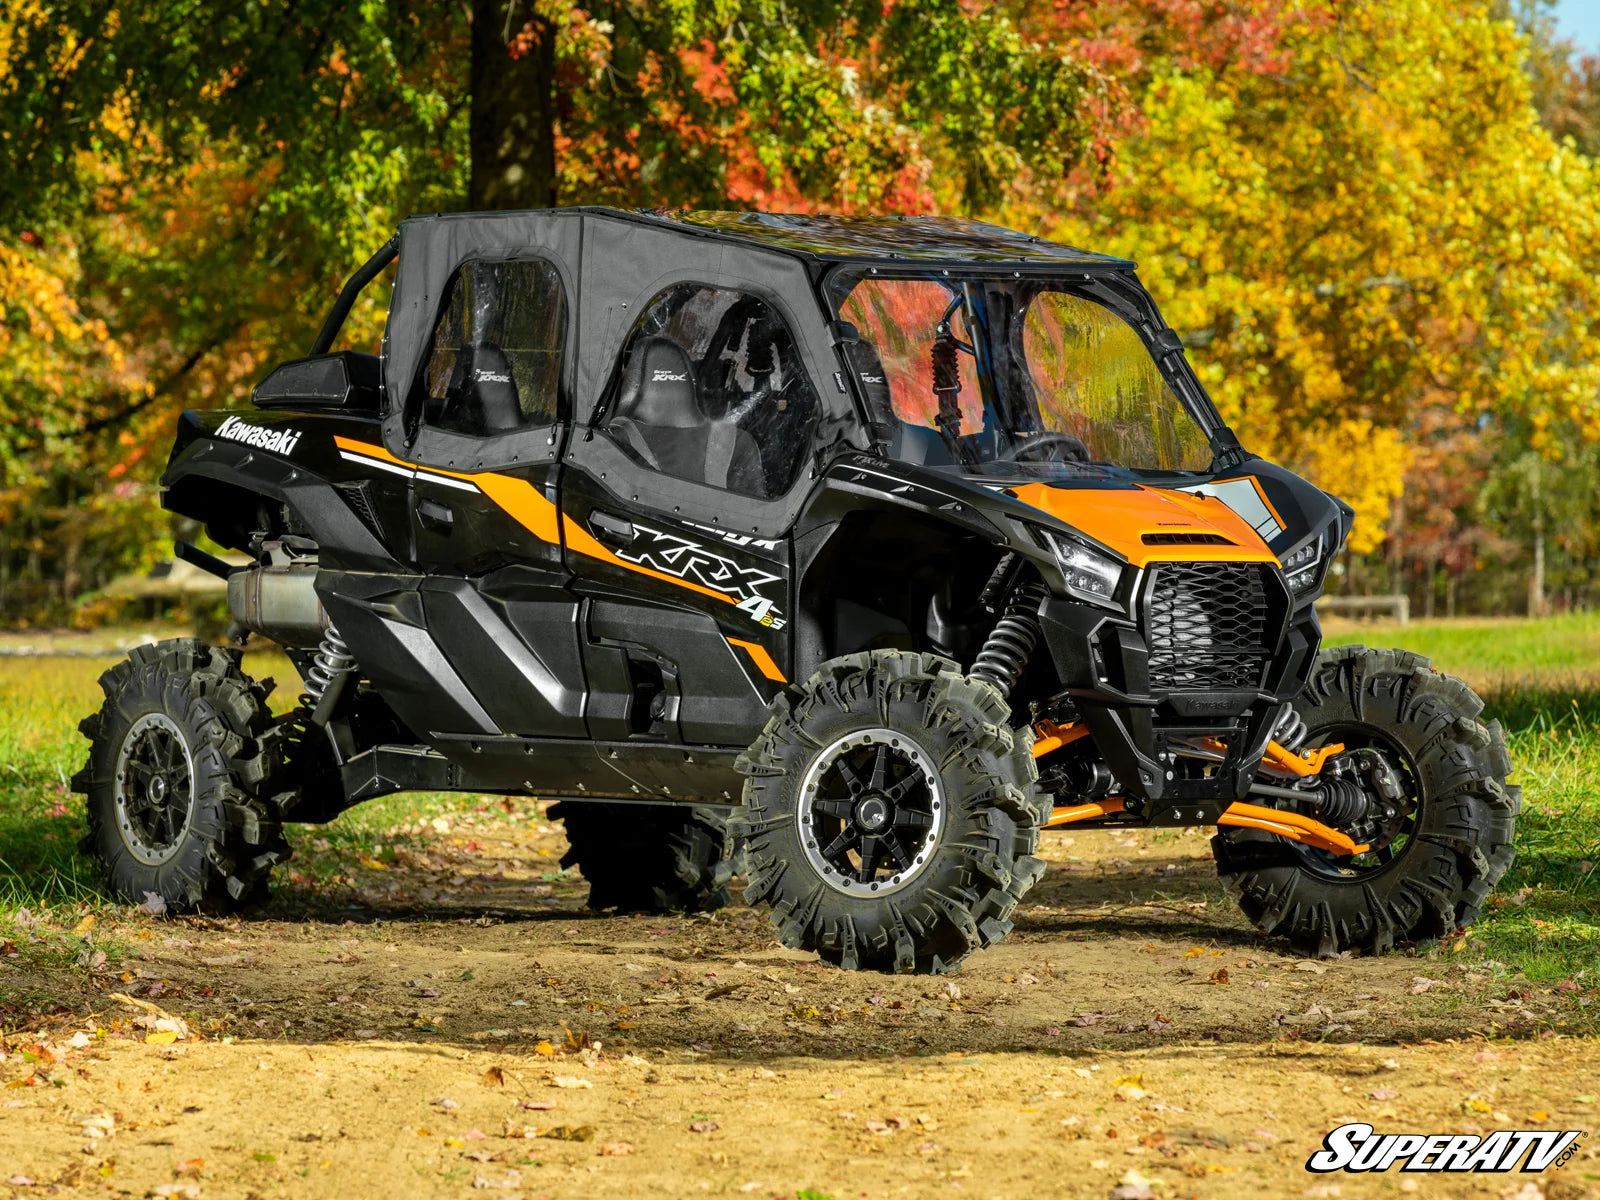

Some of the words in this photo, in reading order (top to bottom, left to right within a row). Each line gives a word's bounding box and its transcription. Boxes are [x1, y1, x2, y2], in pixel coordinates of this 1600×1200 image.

[652, 373, 687, 381] KRX
[214, 416, 303, 456] Kawasaki
[615, 523, 783, 601] KRX
